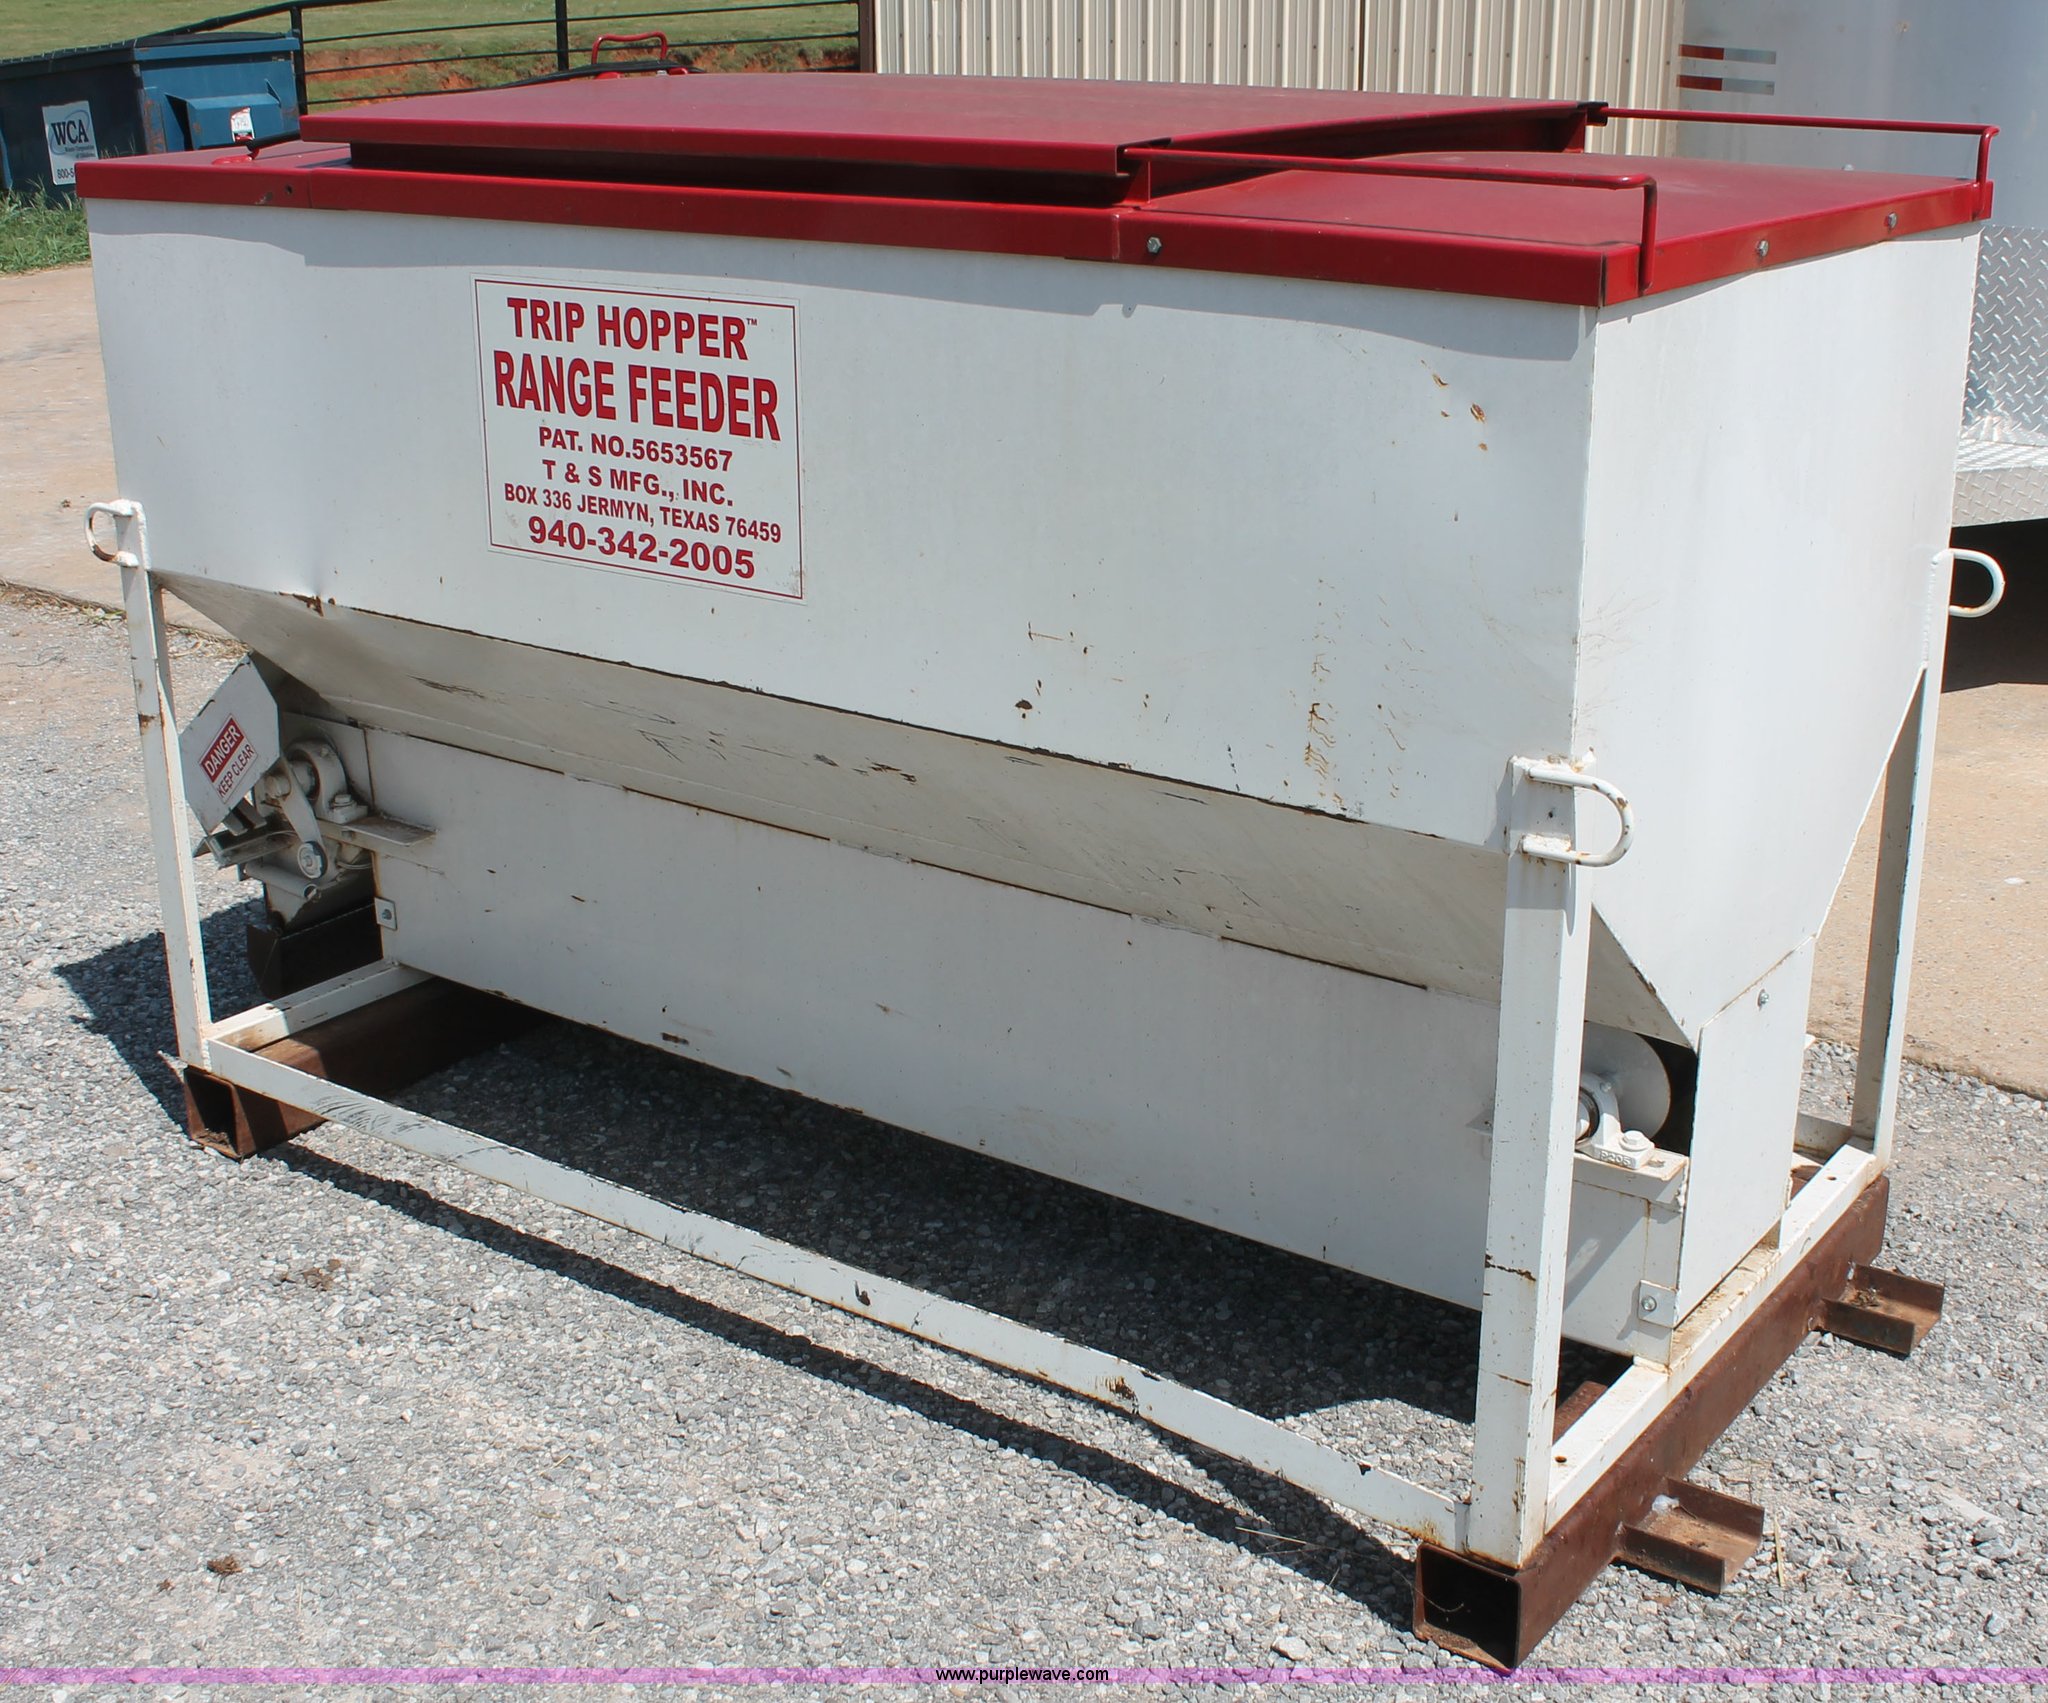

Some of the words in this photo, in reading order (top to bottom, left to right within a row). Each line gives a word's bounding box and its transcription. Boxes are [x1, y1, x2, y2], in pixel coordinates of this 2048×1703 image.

[51, 119, 89, 145] WCA
[507, 297, 585, 343] TRIP
[597, 305, 748, 361] HOPPER
[494, 350, 617, 421] RANGE
[628, 364, 781, 442] FEEDER
[539, 426, 583, 452] PAT.
[591, 433, 733, 472] NO.5653567
[542, 459, 556, 480] T
[564, 462, 580, 484] &
[588, 465, 603, 487] S
[610, 468, 675, 503] MFG.,
[683, 478, 734, 507] INC.
[504, 483, 537, 506] BOX
[542, 488, 572, 511] 336
[577, 494, 655, 528] JERMYN,
[659, 506, 720, 534] TEXAS
[725, 516, 781, 544] 76459
[528, 516, 755, 579] 940-342-2005
[203, 724, 241, 777] DANGER
[216, 771, 234, 798] KEEP
[232, 743, 255, 777] CLEAR
